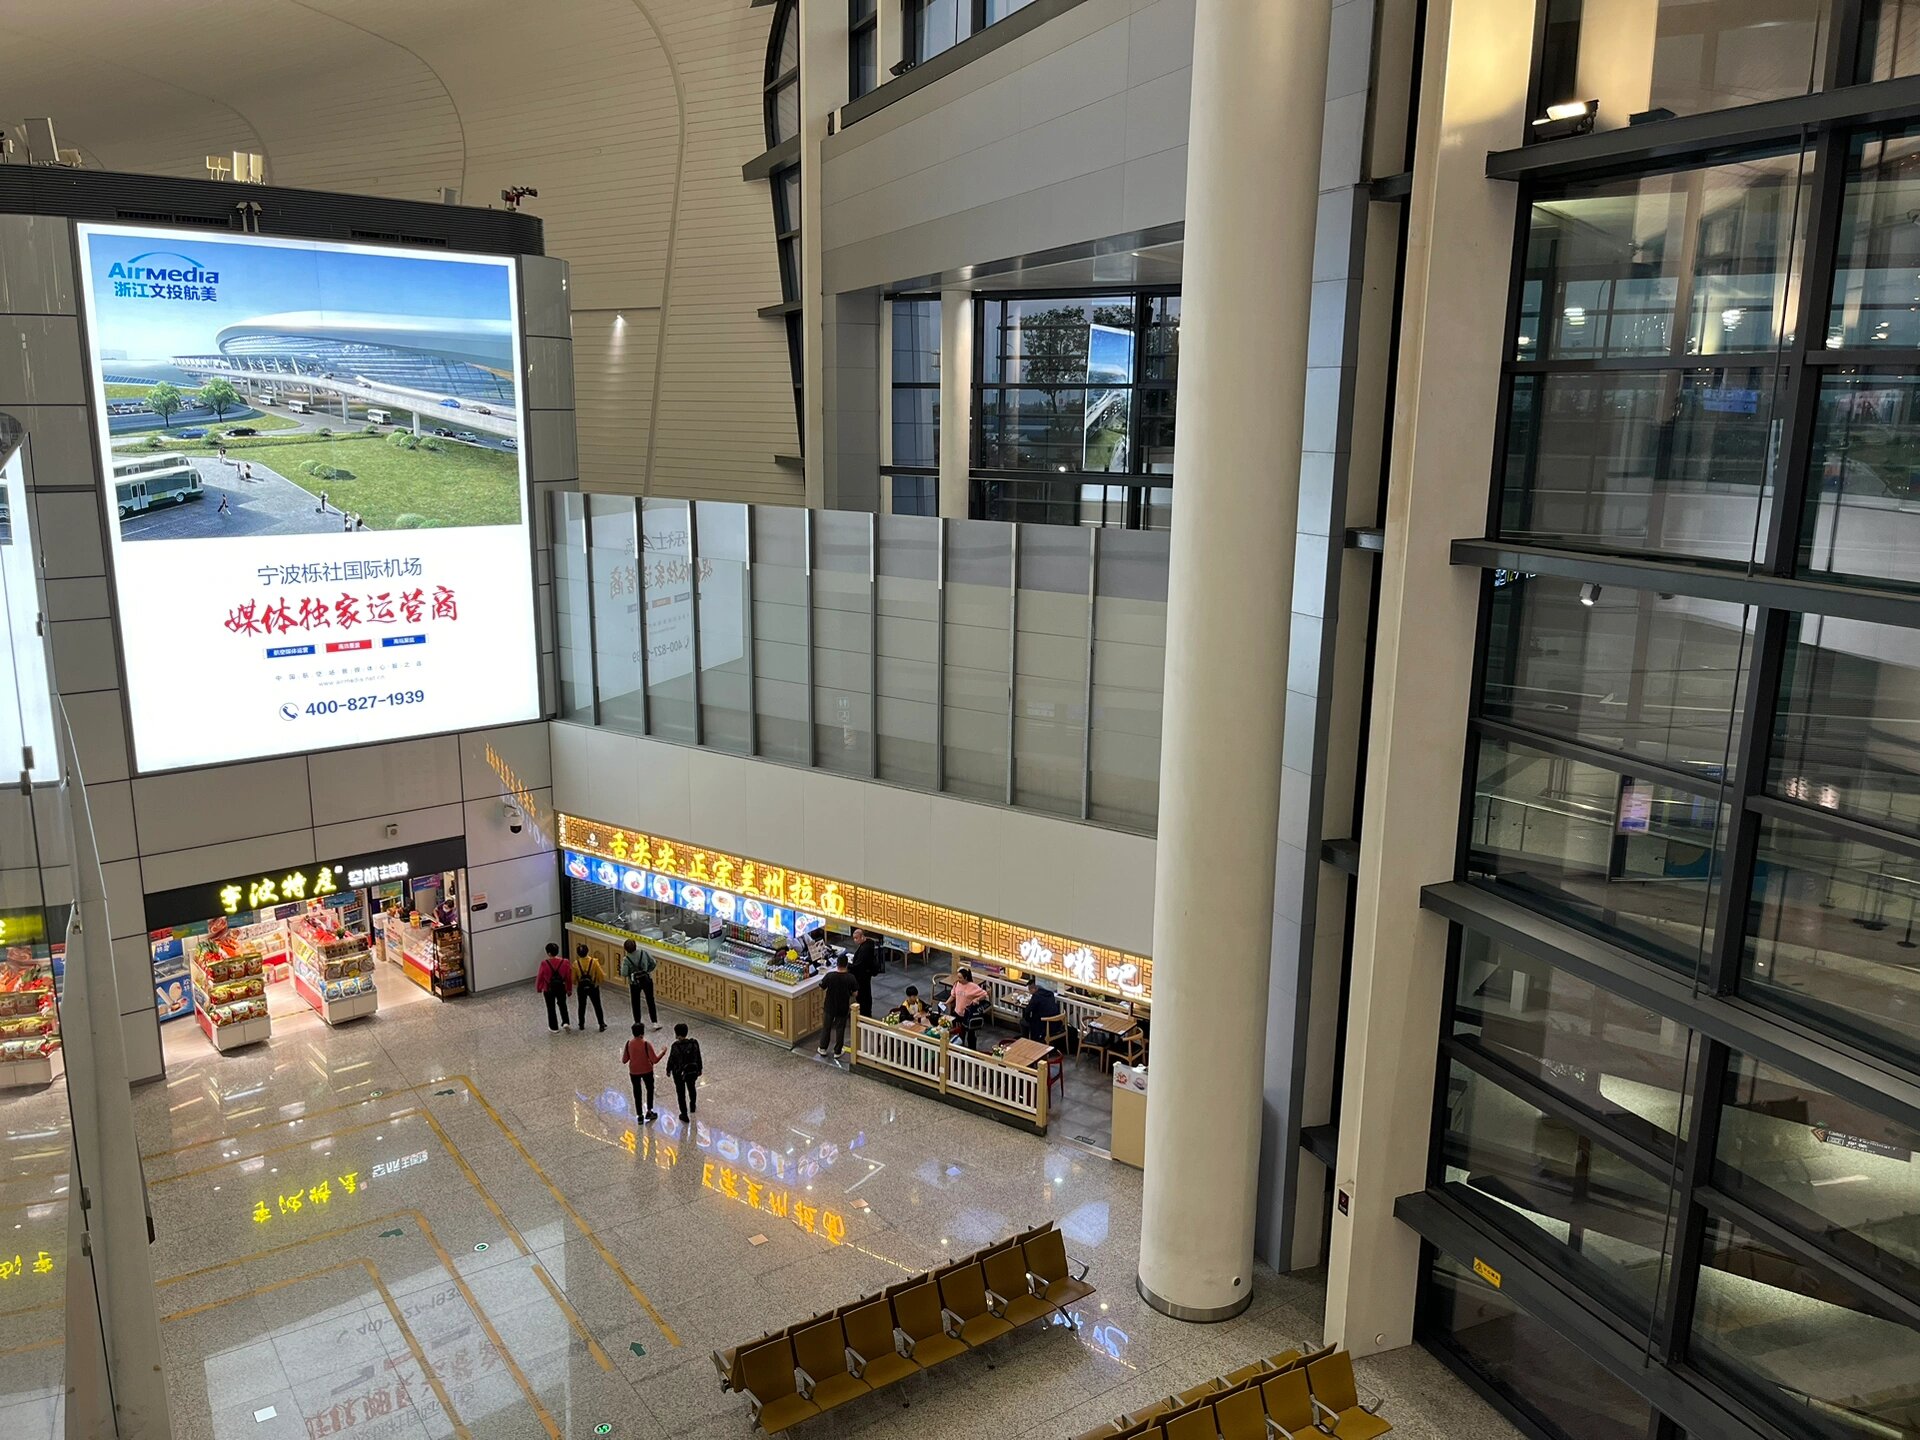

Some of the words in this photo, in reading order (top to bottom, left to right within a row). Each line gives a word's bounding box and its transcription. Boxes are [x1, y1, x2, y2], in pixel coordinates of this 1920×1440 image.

[114, 281, 217, 302] 浙江文投航美
[257, 557, 422, 586] 宁波栎社国际机场
[223, 585, 459, 638] 媒体独家运营商
[305, 690, 424, 716] 400-827-1939
[1020, 938, 1143, 994] 咖啡吧
